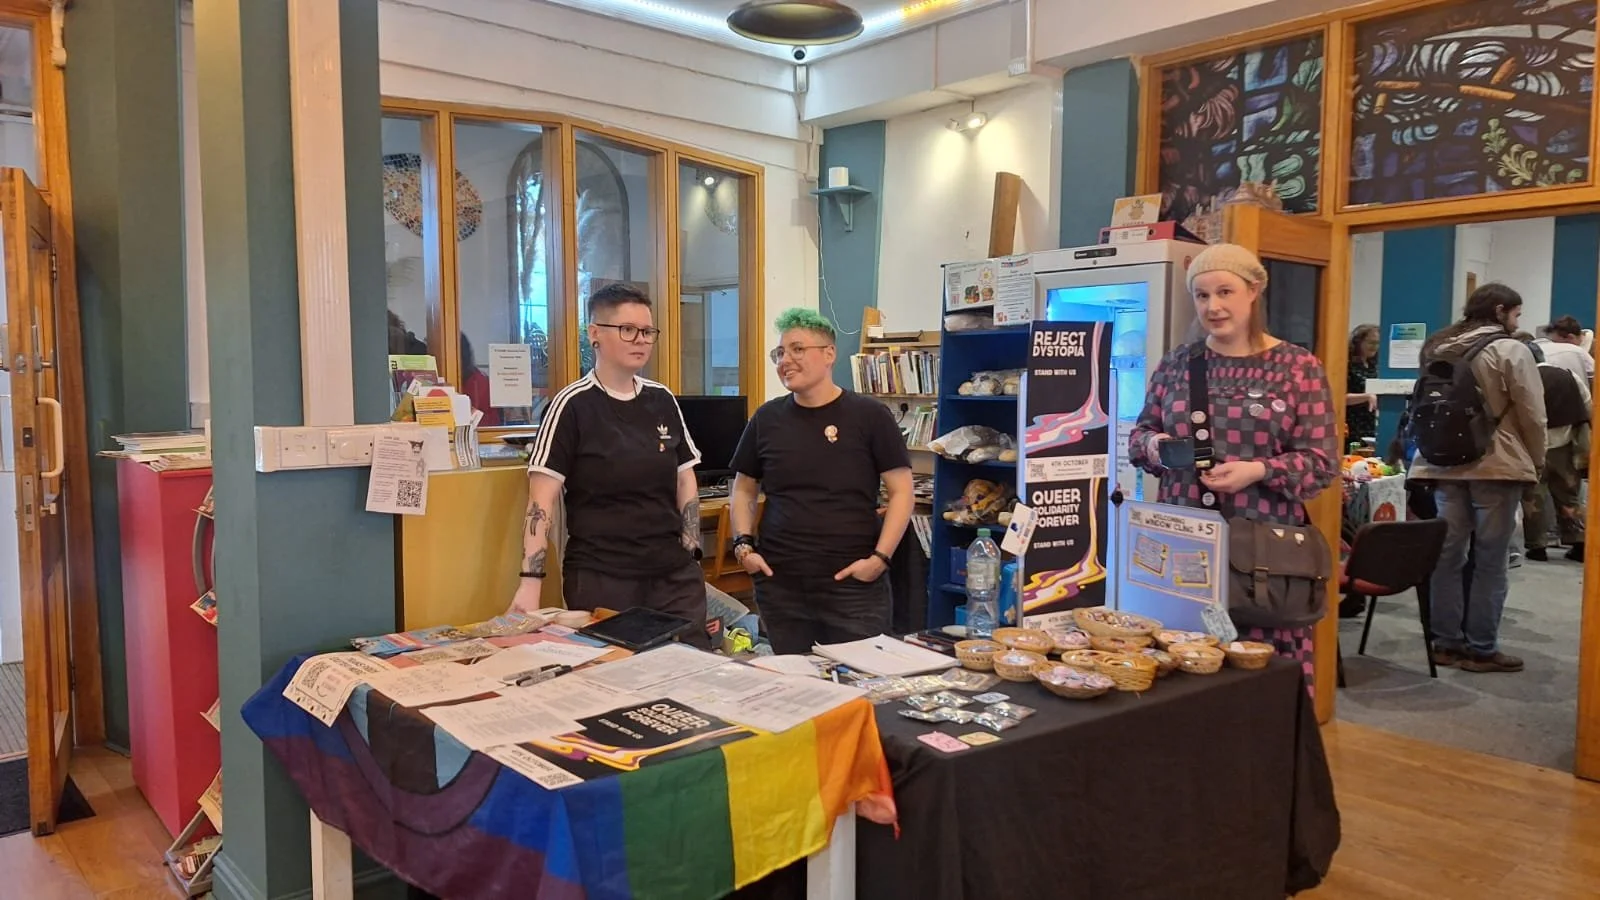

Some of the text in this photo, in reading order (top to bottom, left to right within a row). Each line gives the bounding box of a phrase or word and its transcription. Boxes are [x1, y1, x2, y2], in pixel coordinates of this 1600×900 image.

[1034, 331, 1086, 345] REJECT
[1032, 346, 1085, 357] DYSTOPIA
[1032, 488, 1081, 505] QUEER
[1145, 518, 1171, 529] WINDOW
[1173, 522, 1194, 533] CLING
[1033, 541, 1051, 549] STAND
[622, 710, 678, 735] FOREVER
[651, 703, 711, 728] QUEER
